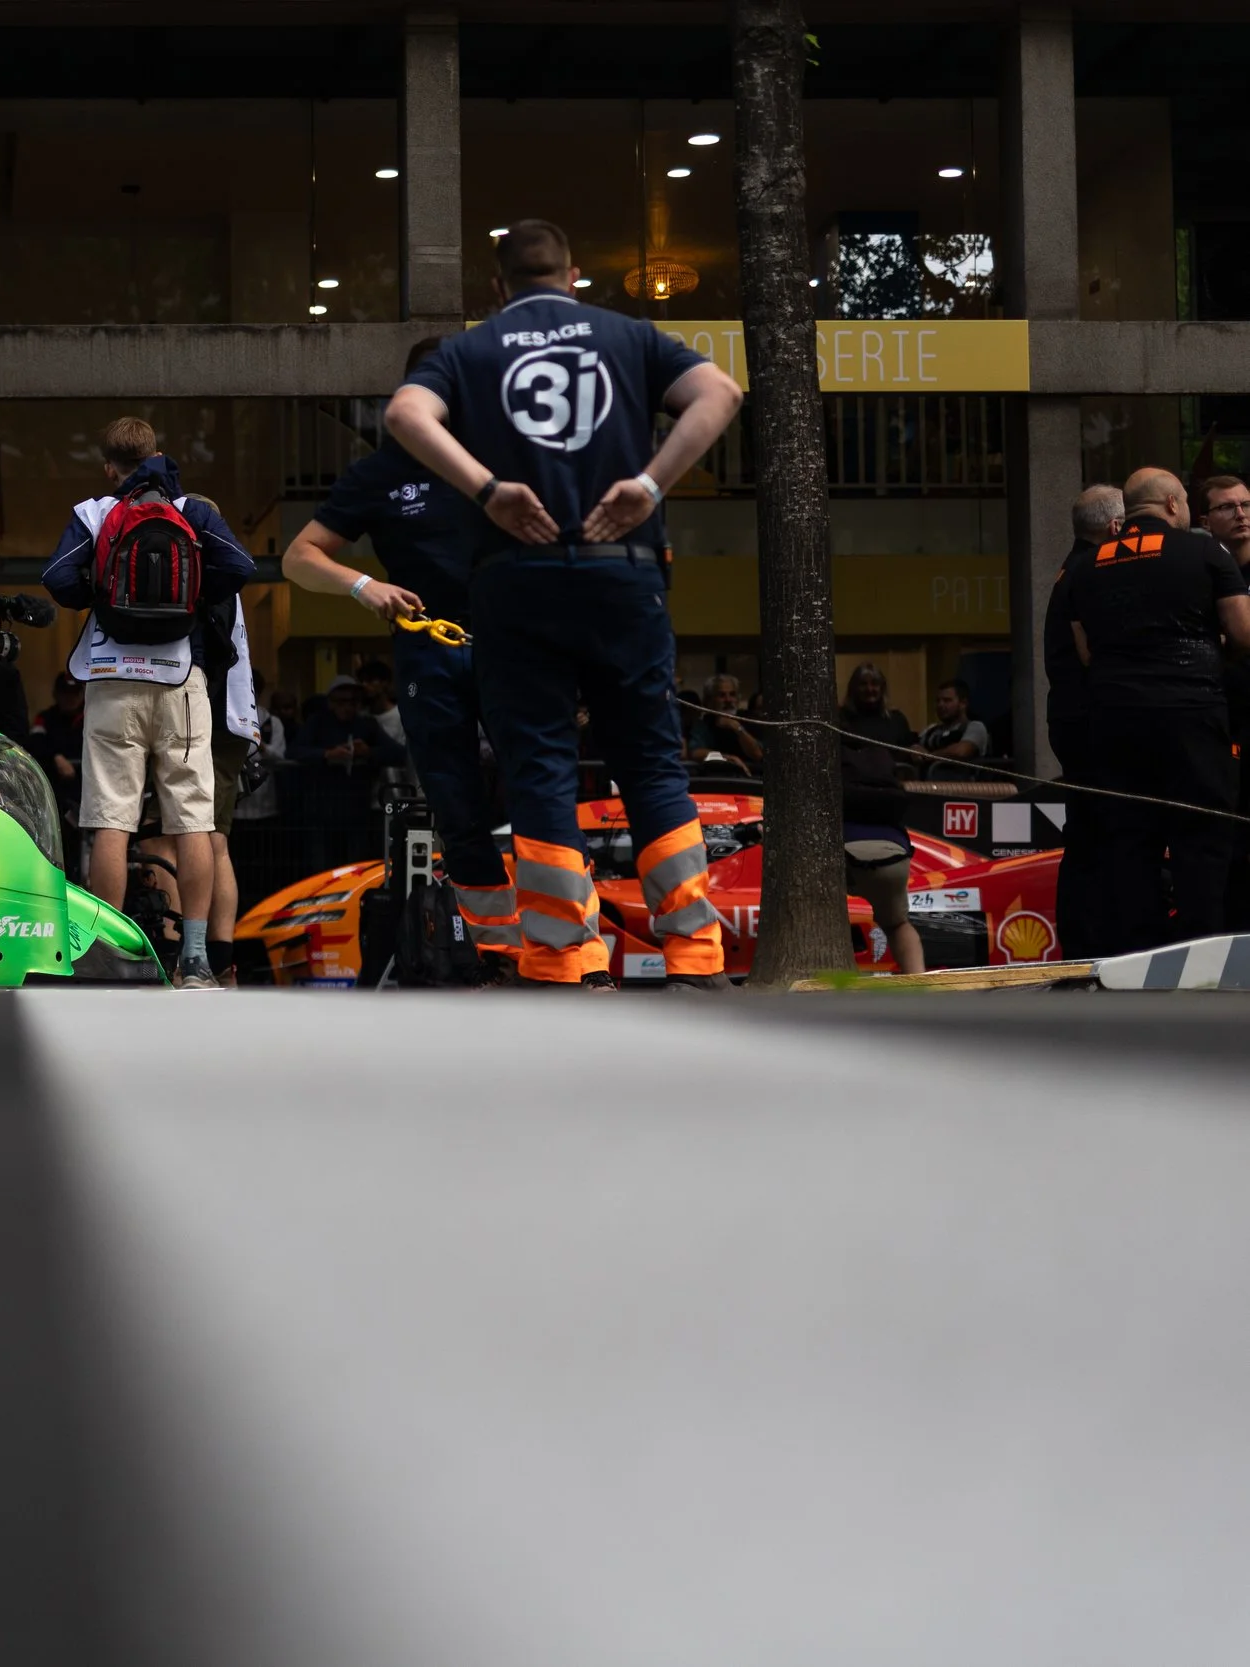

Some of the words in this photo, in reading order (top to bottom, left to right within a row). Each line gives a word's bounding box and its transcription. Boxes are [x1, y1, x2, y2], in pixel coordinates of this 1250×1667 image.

[502, 322, 592, 348] PESAGE
[513, 351, 598, 452] 3j
[134, 667, 154, 675] BOSCH
[946, 809, 974, 831] HY
